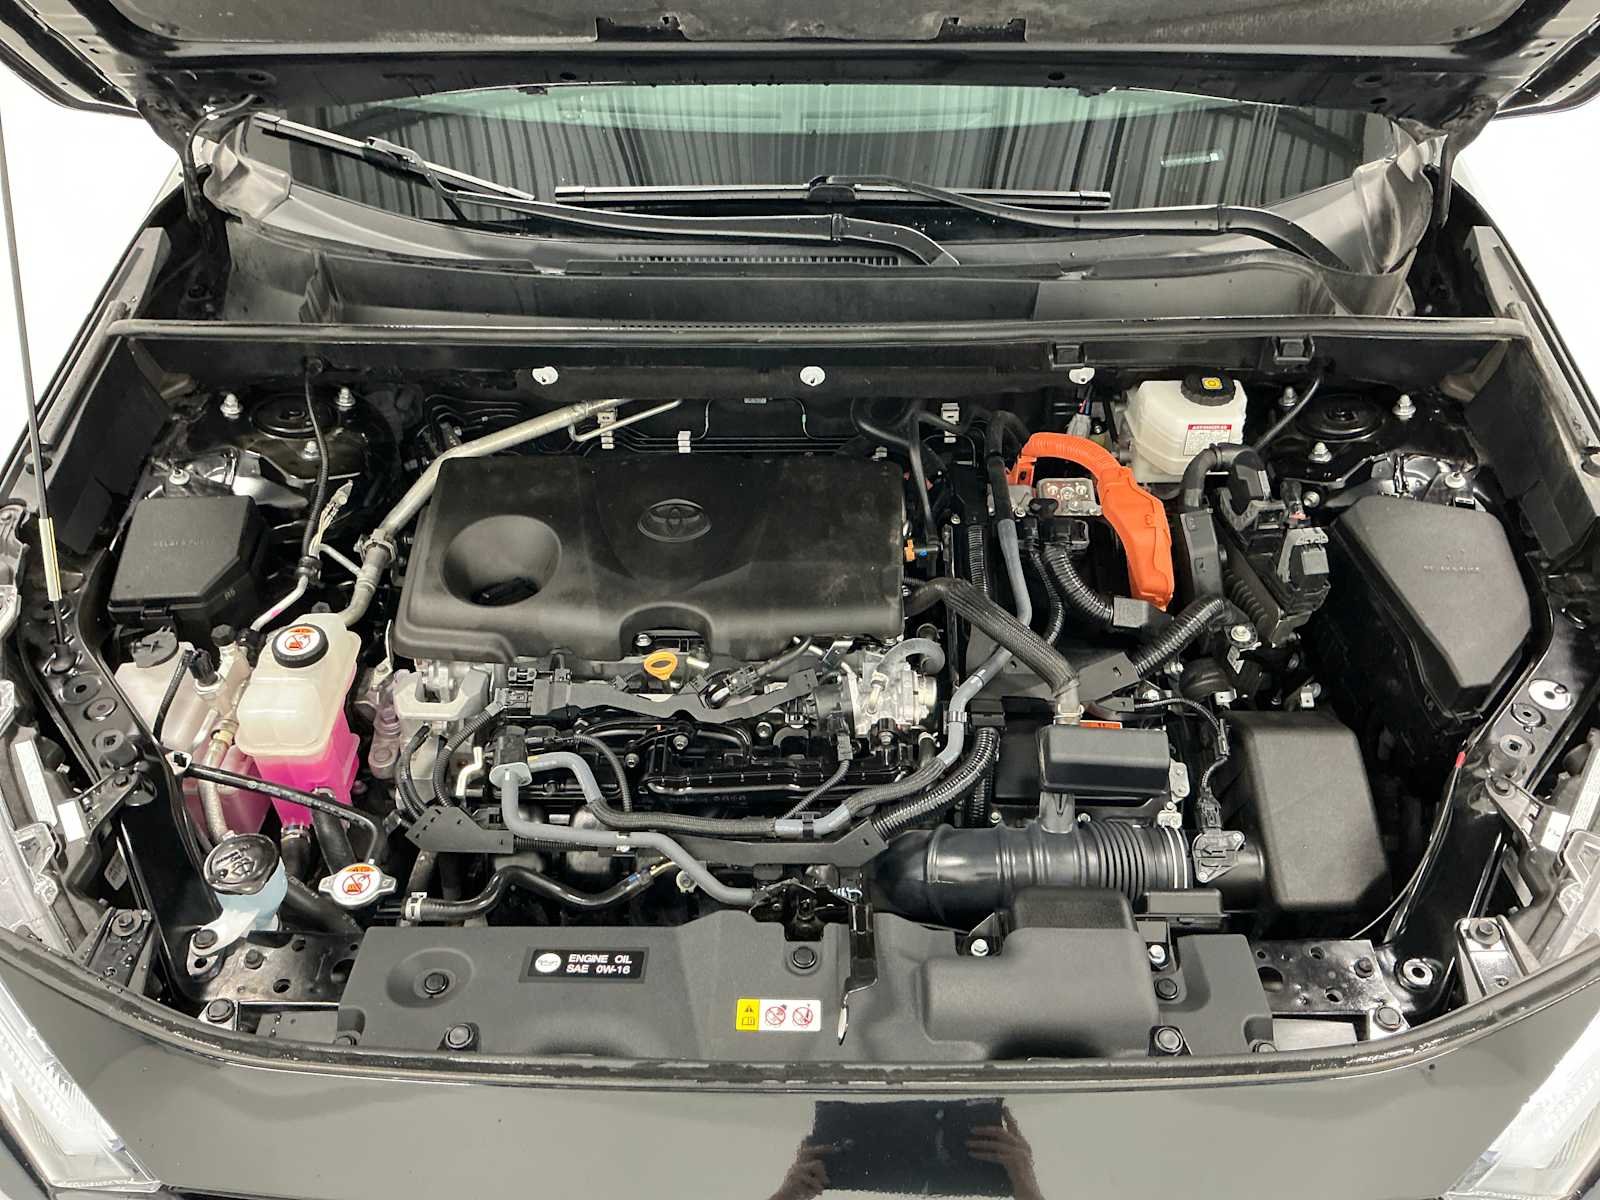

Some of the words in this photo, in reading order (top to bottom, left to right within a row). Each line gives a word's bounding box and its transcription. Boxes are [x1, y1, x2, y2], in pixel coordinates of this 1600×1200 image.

[568, 954, 609, 963] ENGINE
[614, 955, 633, 964] OIL
[566, 964, 590, 973] SAE
[596, 965, 631, 974] 0W-16
